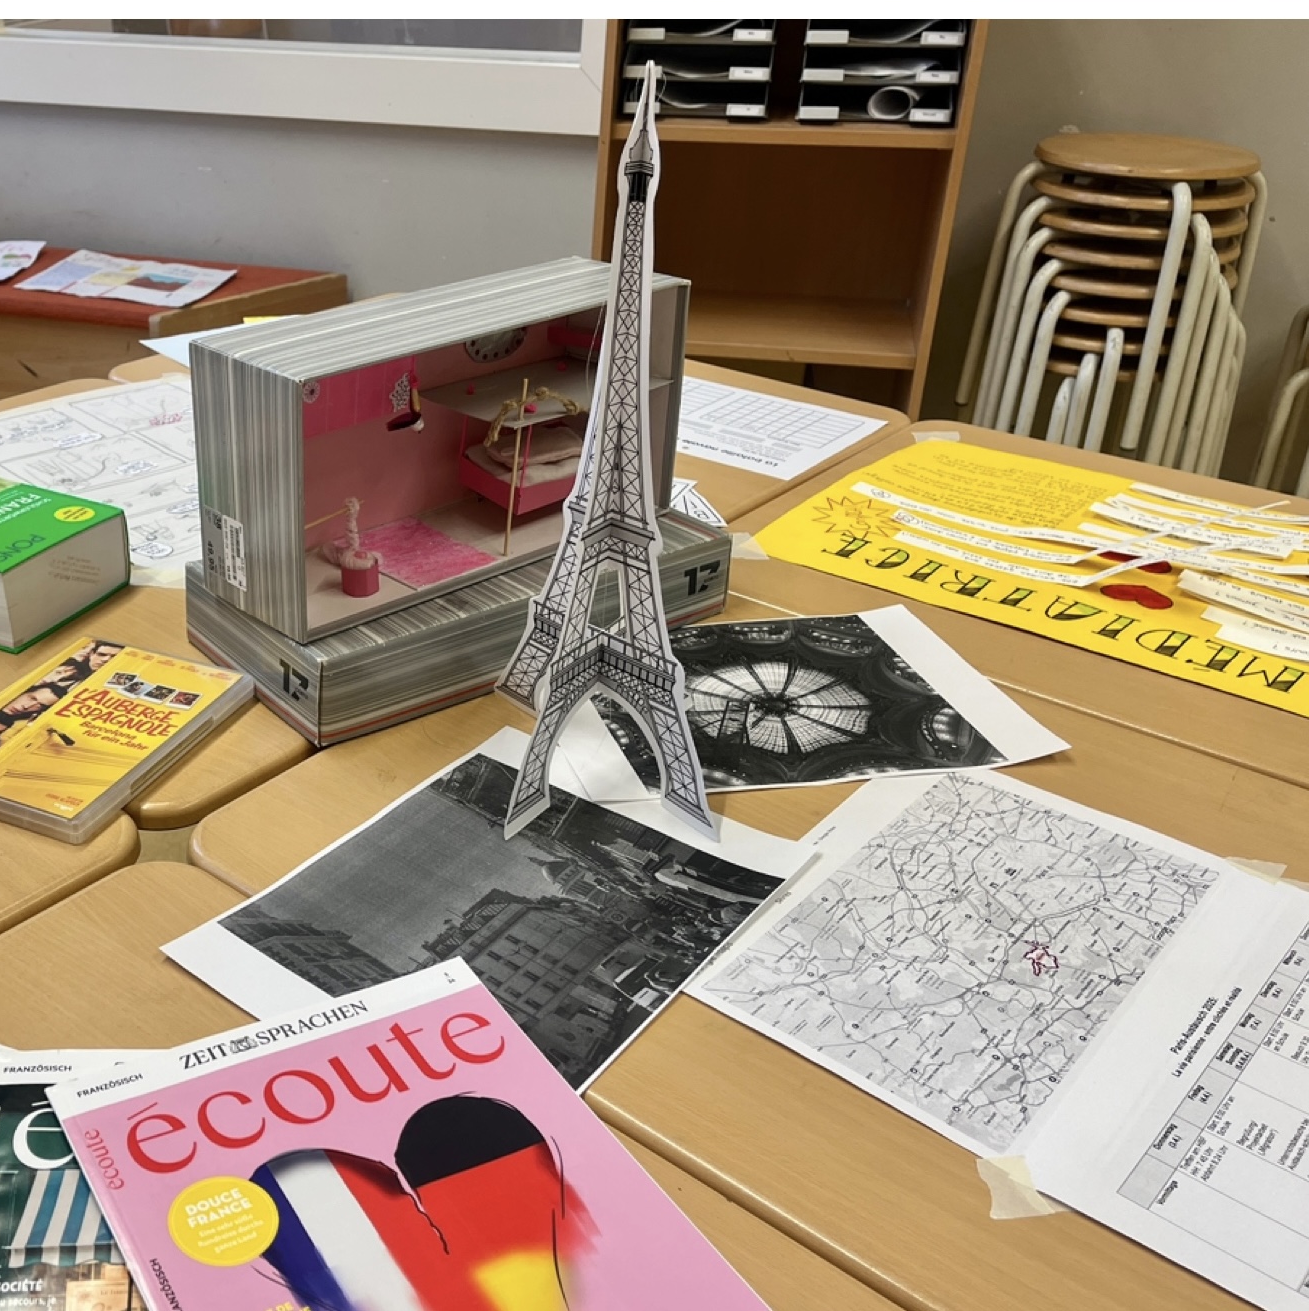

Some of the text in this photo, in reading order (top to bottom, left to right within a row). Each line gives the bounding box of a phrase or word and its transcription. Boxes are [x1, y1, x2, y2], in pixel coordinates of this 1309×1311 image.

[55, 702, 178, 737] ESPAGNOLE
[79, 721, 138, 740] Barcelona
[83, 730, 102, 740] für
[104, 735, 120, 746] ein
[179, 1000, 368, 1070] ZEIT SPRACHEN
[3, 1064, 72, 1073] FRANZÖSISCH
[76, 1073, 143, 1099] FRANZÖSISCH
[125, 1012, 506, 1173] écoute
[185, 1188, 242, 1215] DOUCE
[187, 1197, 253, 1229] FRANCE
